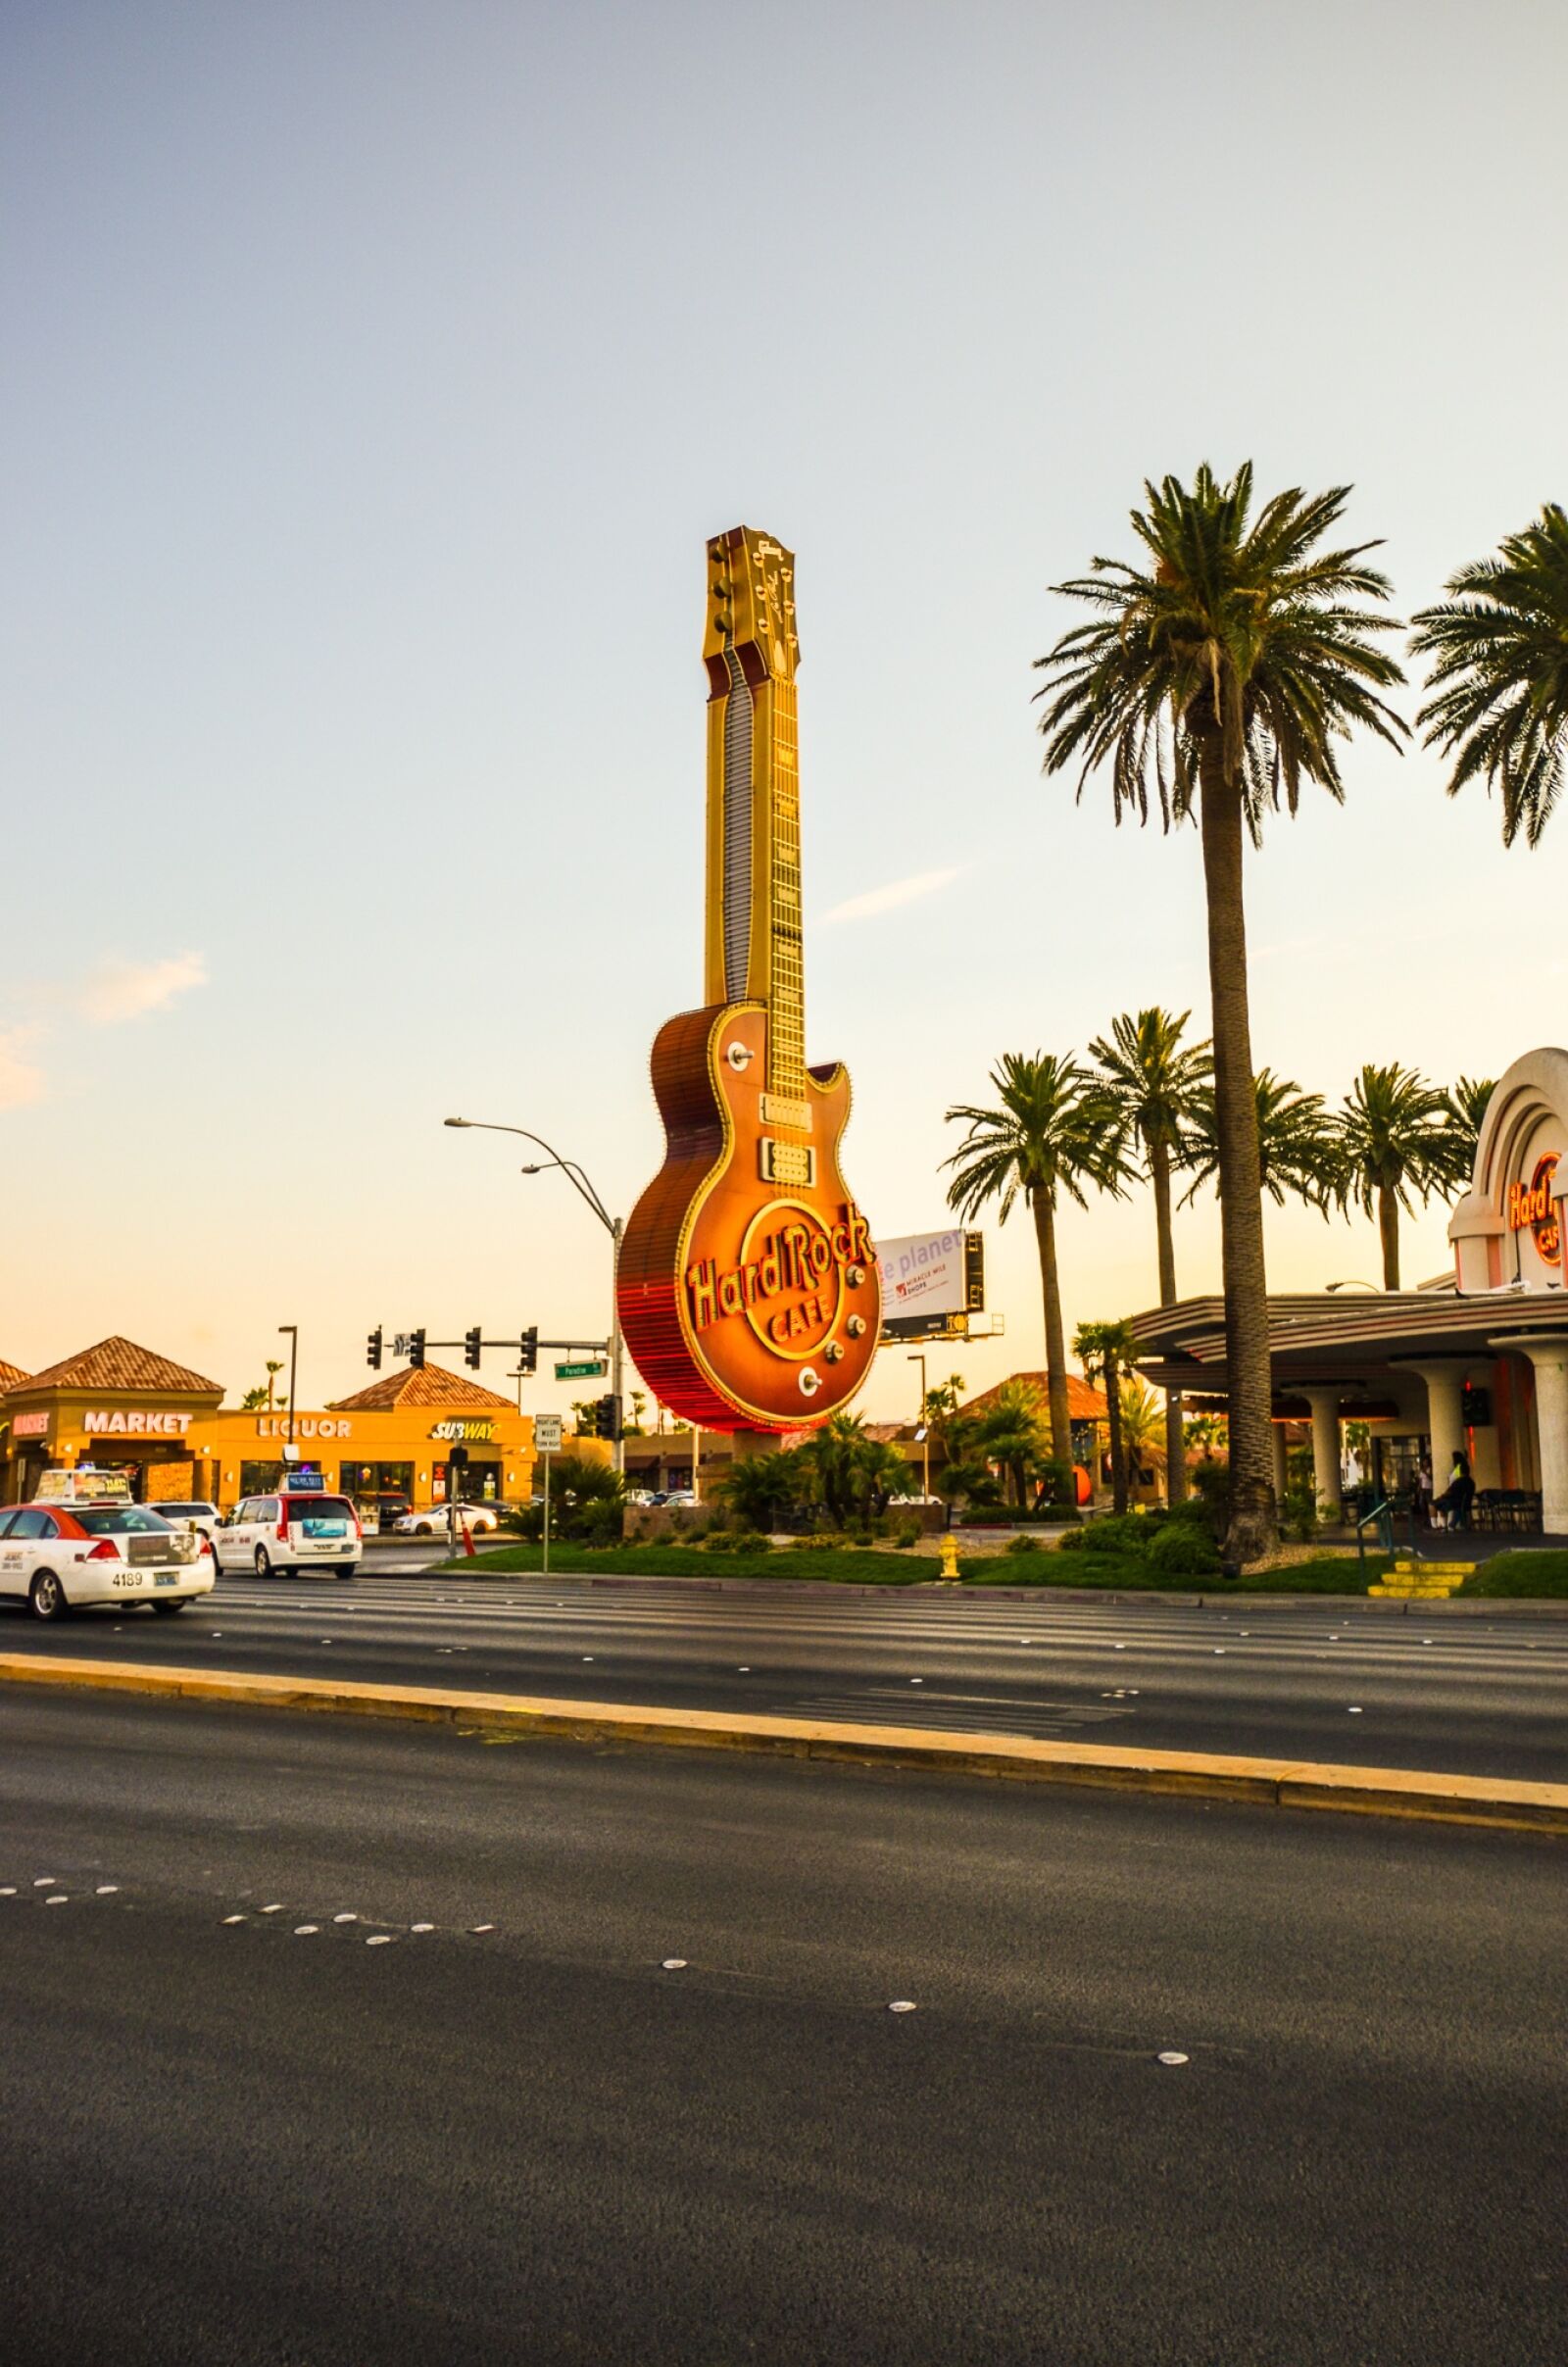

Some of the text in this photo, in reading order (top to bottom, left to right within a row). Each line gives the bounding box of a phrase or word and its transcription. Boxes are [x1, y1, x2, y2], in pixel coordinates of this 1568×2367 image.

[1509, 1175, 1547, 1231] Hard
[1539, 1225, 1559, 1251] CAF
[899, 1229, 961, 1278] planet
[688, 1202, 876, 1332] Hard Rock
[906, 1271, 931, 1285] MIRACLE
[769, 1294, 833, 1343] CAFE
[84, 1411, 193, 1433] MARKET
[258, 1417, 352, 1438] LIQUOR
[431, 1422, 502, 1440] SUBWAY
[113, 1572, 142, 1587] 4189
